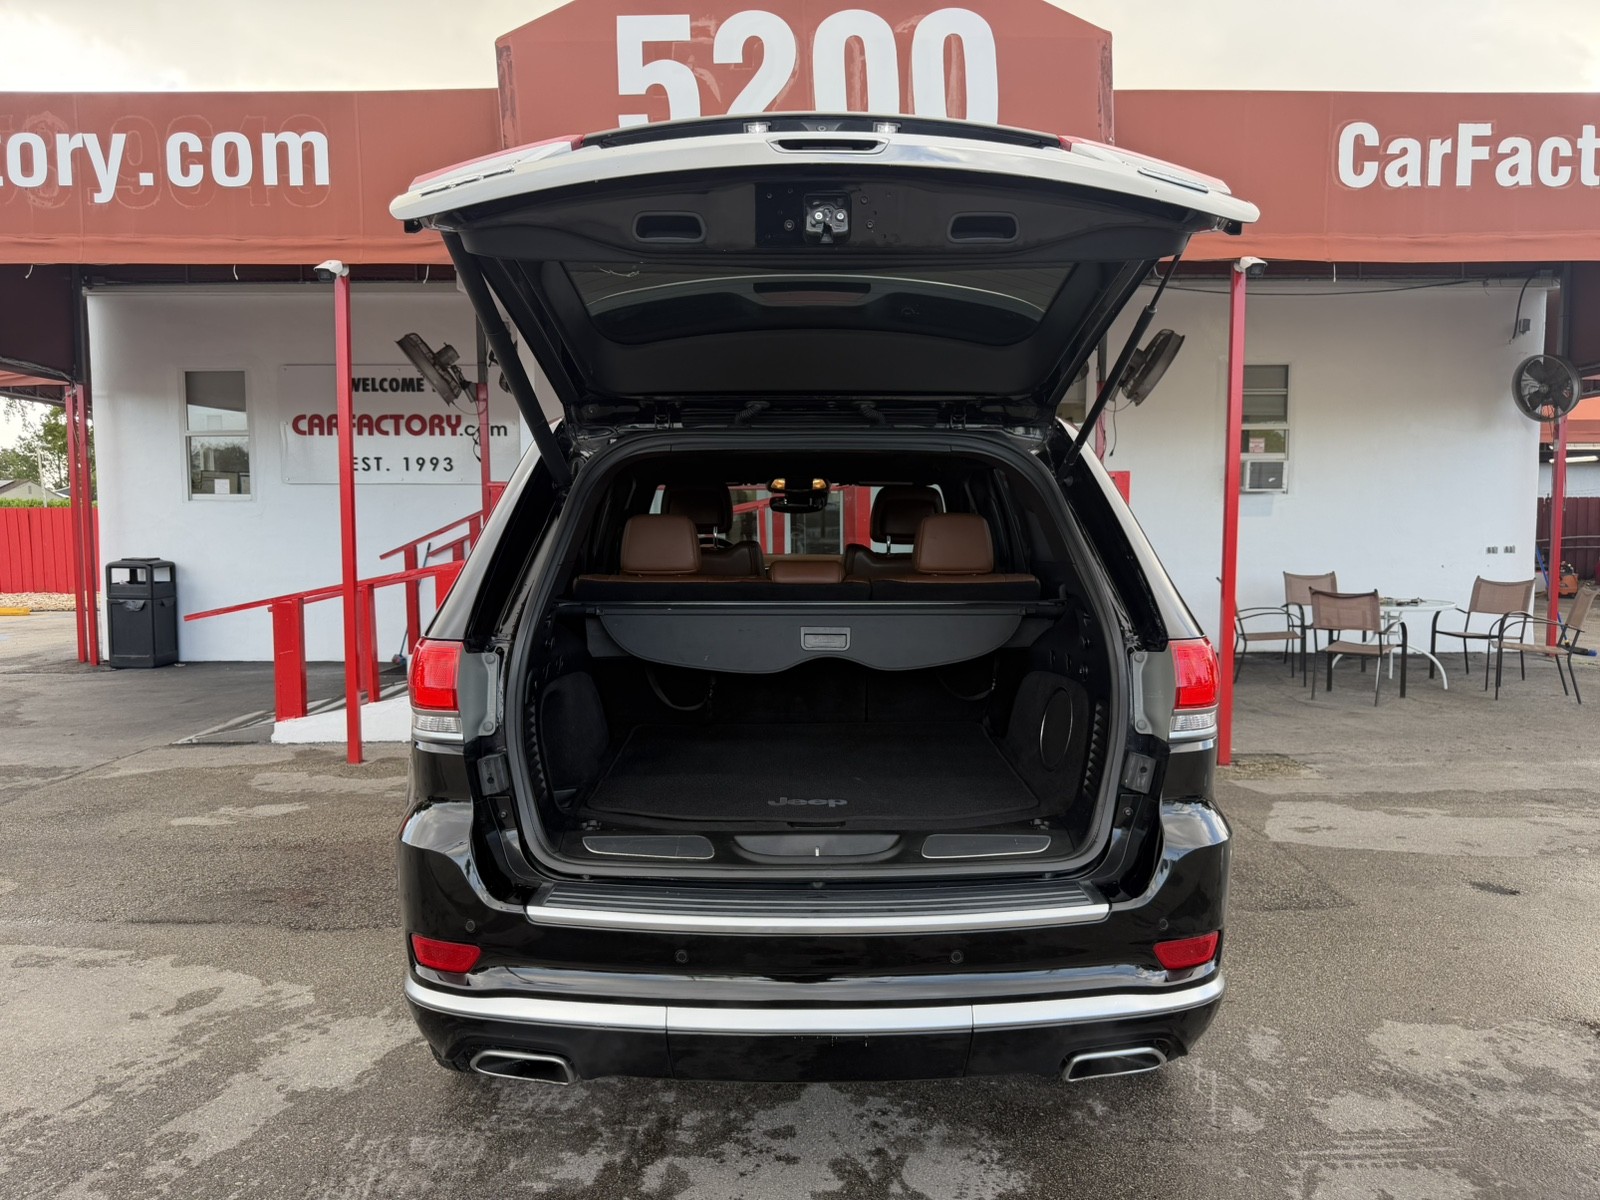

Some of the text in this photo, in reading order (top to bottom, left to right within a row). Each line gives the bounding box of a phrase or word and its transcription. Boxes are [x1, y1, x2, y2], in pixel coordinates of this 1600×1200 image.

[616, 8, 998, 128] 5200
[0, 131, 330, 204] ory.com
[403, 456, 454, 472] 1993
[767, 796, 848, 808] Jeep
